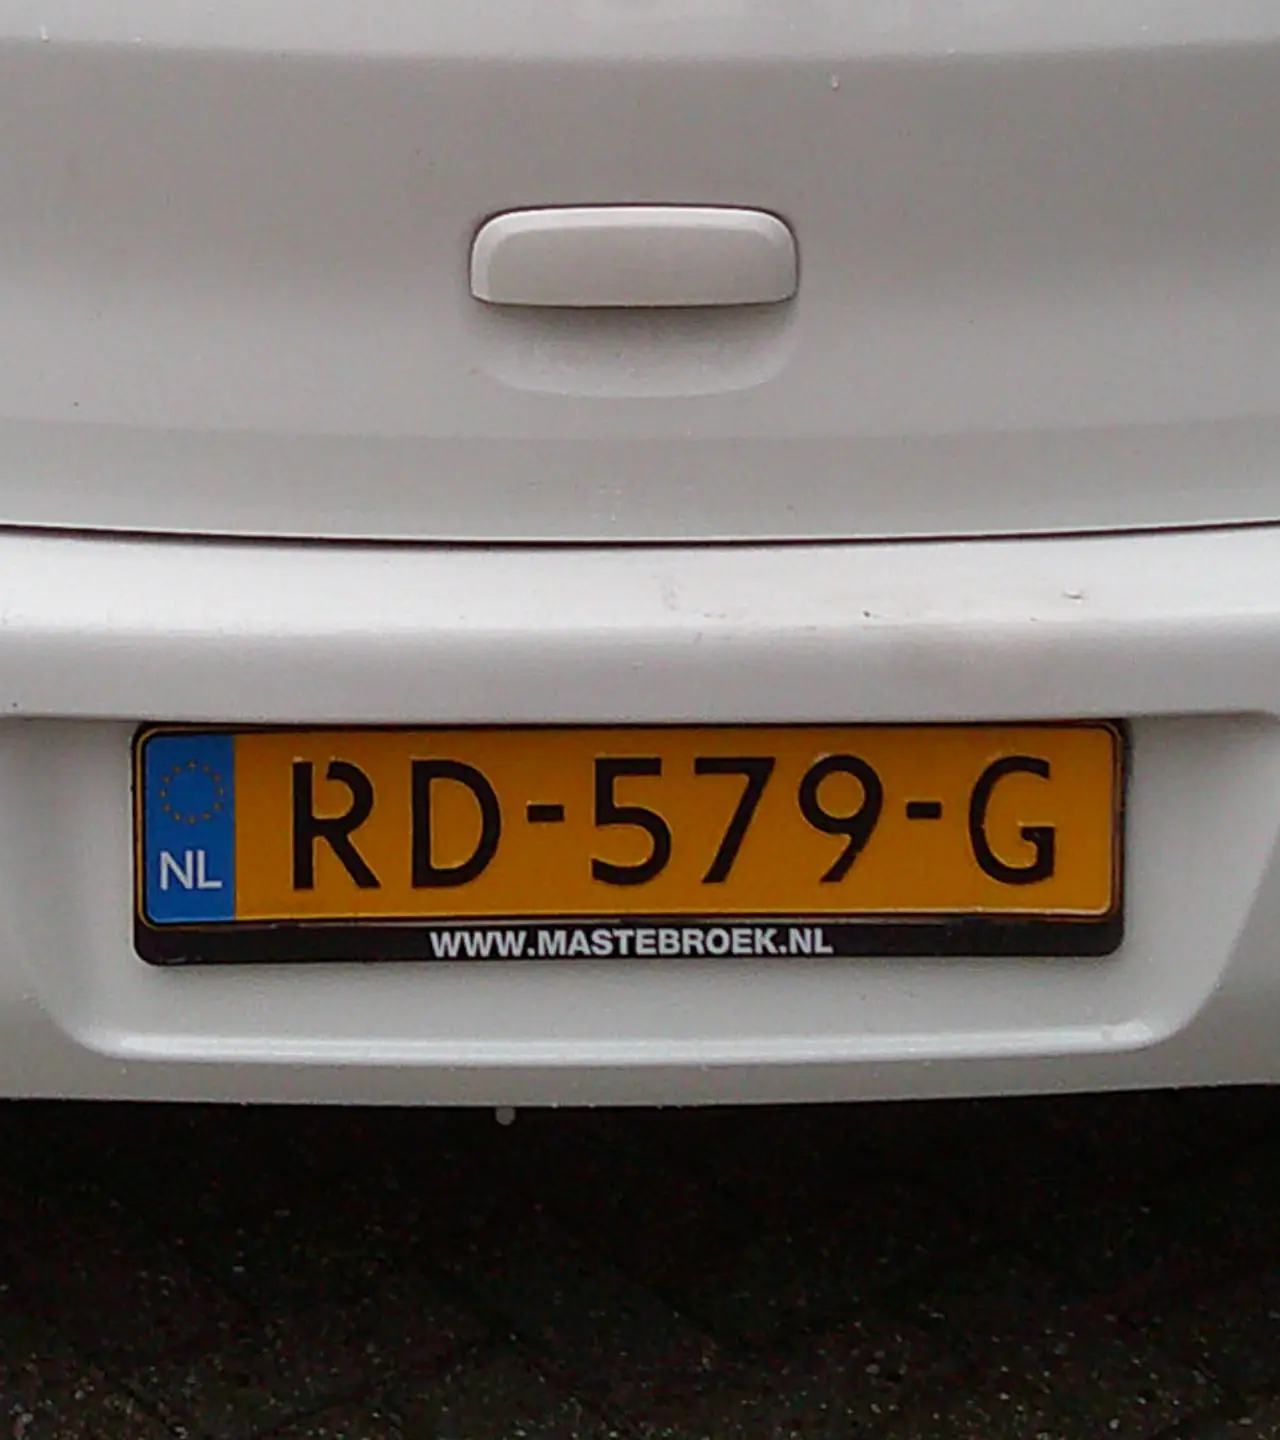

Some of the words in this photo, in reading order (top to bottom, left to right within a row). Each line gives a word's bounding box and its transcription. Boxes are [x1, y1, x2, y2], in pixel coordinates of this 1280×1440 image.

[292, 753, 1055, 891] RD-579-G
[158, 849, 223, 892] NL
[429, 928, 834, 958] WWW.MASTEBROEK.NL
